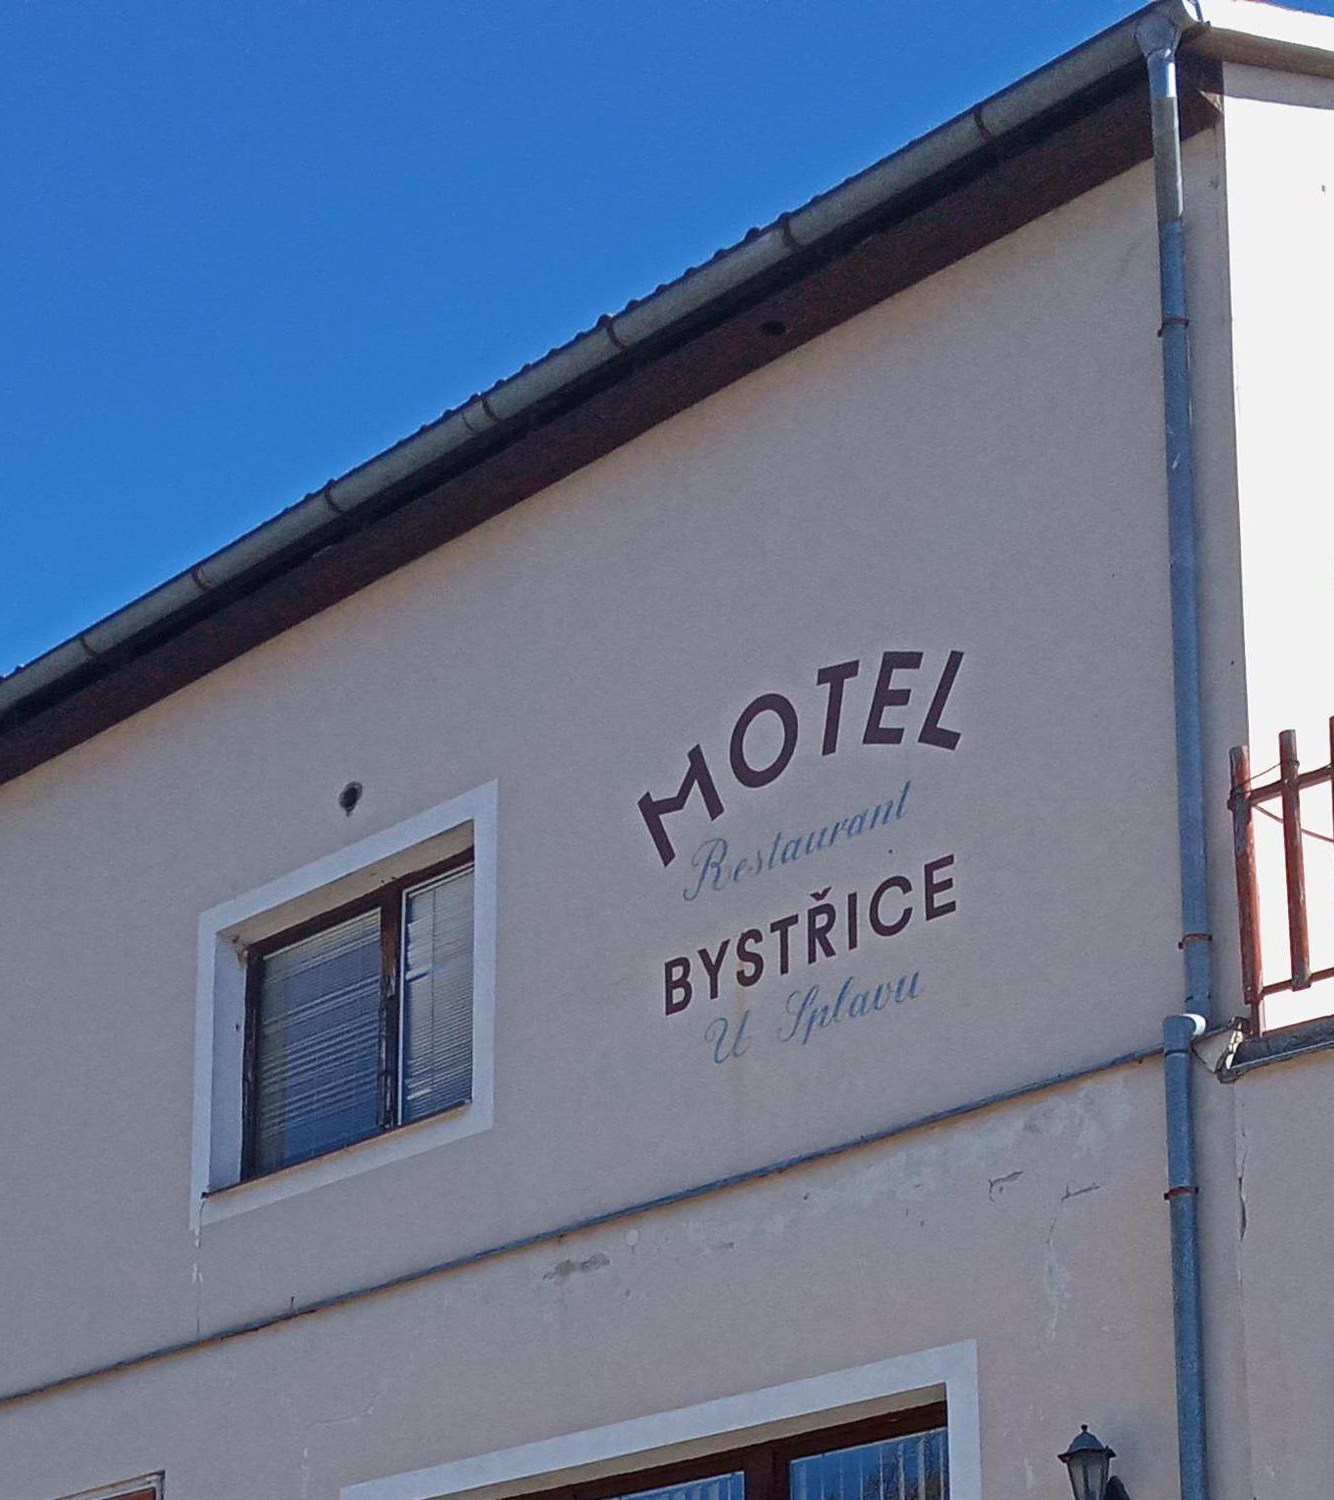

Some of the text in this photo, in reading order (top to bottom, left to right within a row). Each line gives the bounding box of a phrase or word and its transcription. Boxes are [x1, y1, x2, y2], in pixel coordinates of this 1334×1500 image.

[637, 650, 965, 868] MOTEL
[683, 780, 912, 901] Restaurant
[664, 854, 957, 1016] BYSTŘICE
[704, 1010, 752, 1064] U
